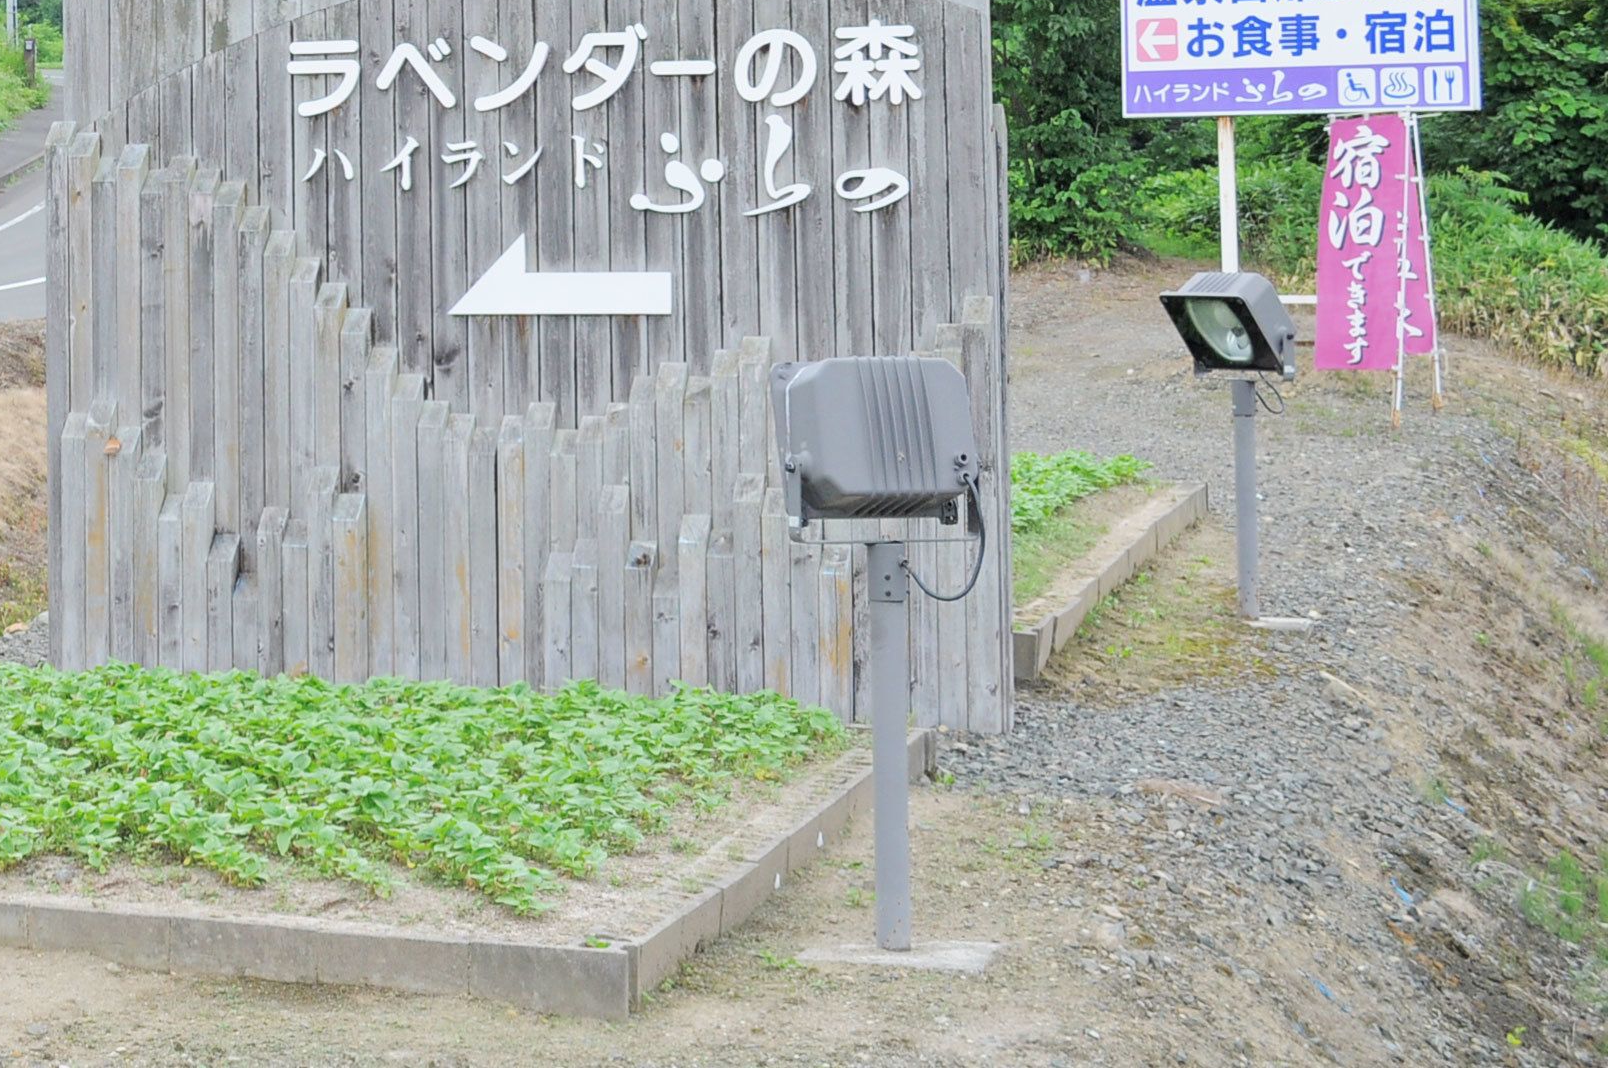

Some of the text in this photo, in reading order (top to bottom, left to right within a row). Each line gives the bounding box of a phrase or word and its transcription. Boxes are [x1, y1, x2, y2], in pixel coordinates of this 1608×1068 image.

[287, 18, 923, 118] ラベンダーの森
[1187, 9, 1456, 59] お食事・宿泊
[301, 134, 609, 192] ハイランド
[1327, 124, 1390, 365] 宿泊できます
